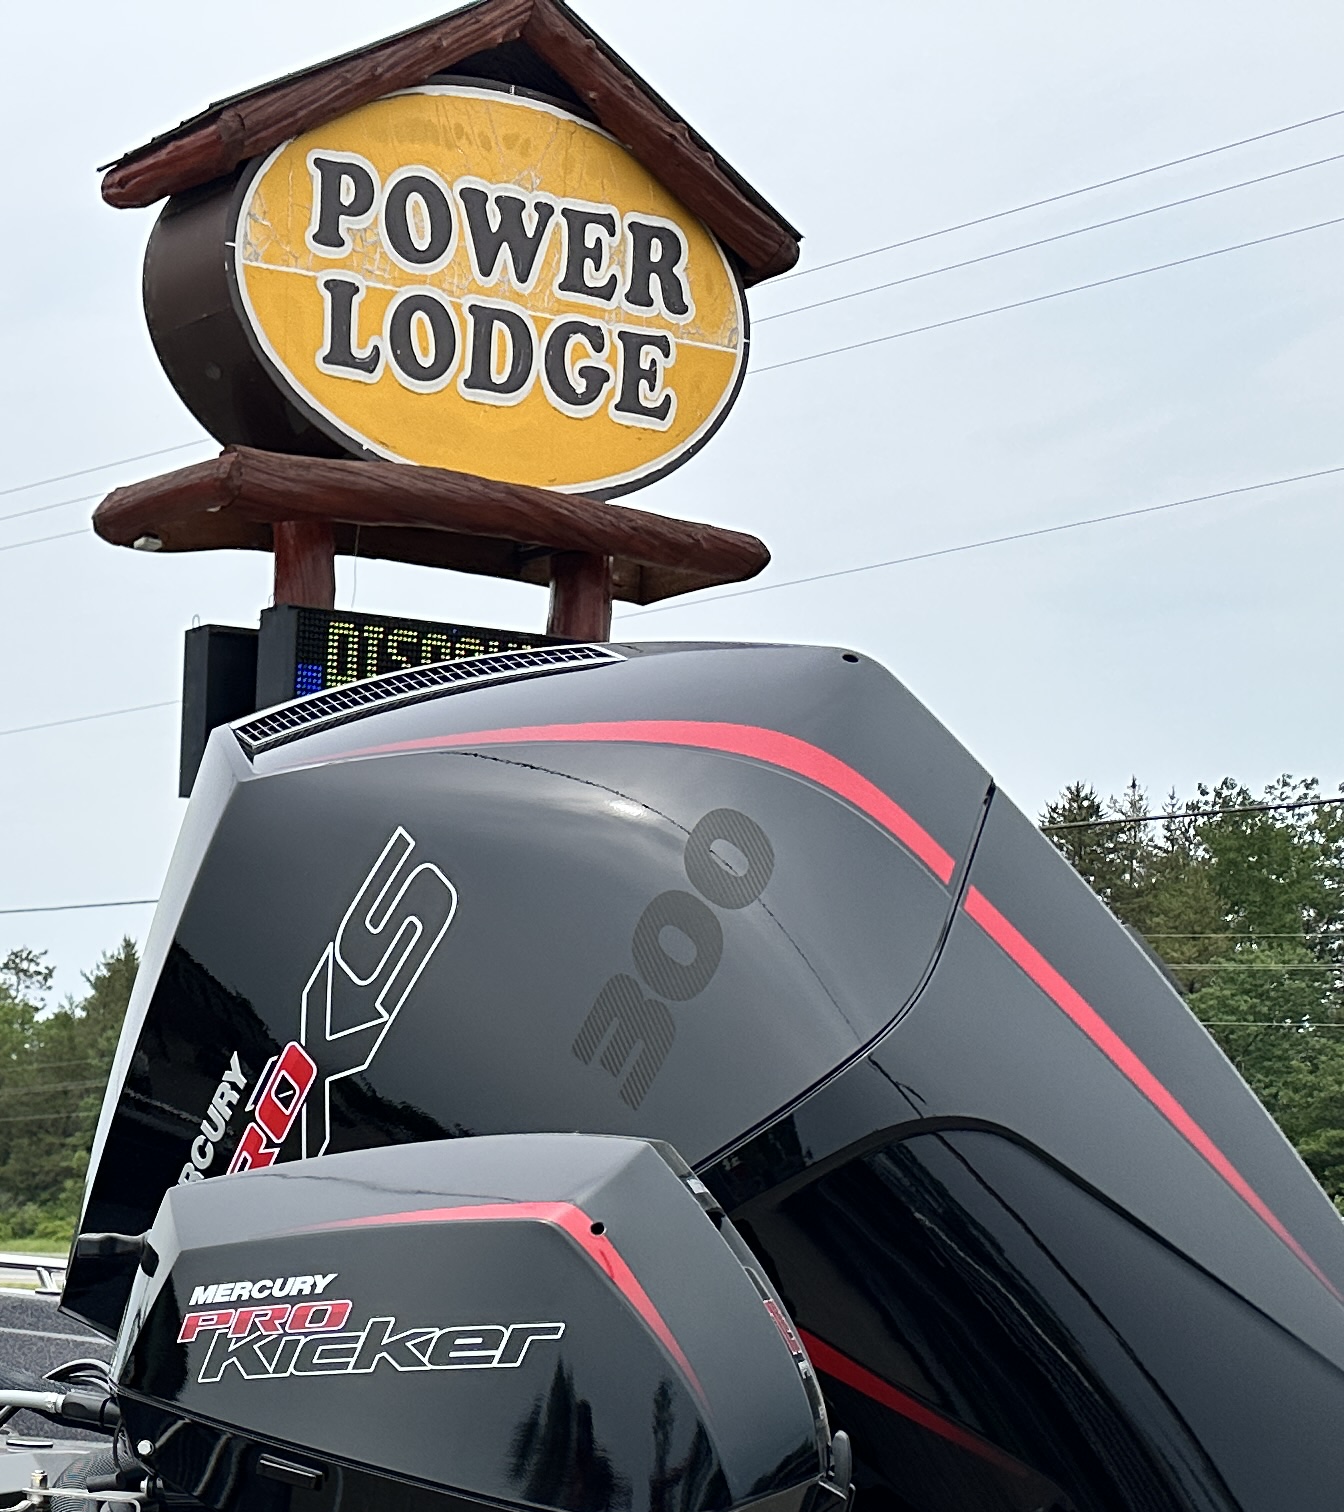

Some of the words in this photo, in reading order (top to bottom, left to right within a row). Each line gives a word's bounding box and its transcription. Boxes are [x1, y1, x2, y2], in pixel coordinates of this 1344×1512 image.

[310, 154, 691, 318] POWER
[318, 277, 675, 424] LODGE
[570, 807, 776, 1112] 300
[177, 1050, 248, 1186] RCURY
[177, 1299, 354, 1344] PRO
[188, 1272, 339, 1306] MERCURY
